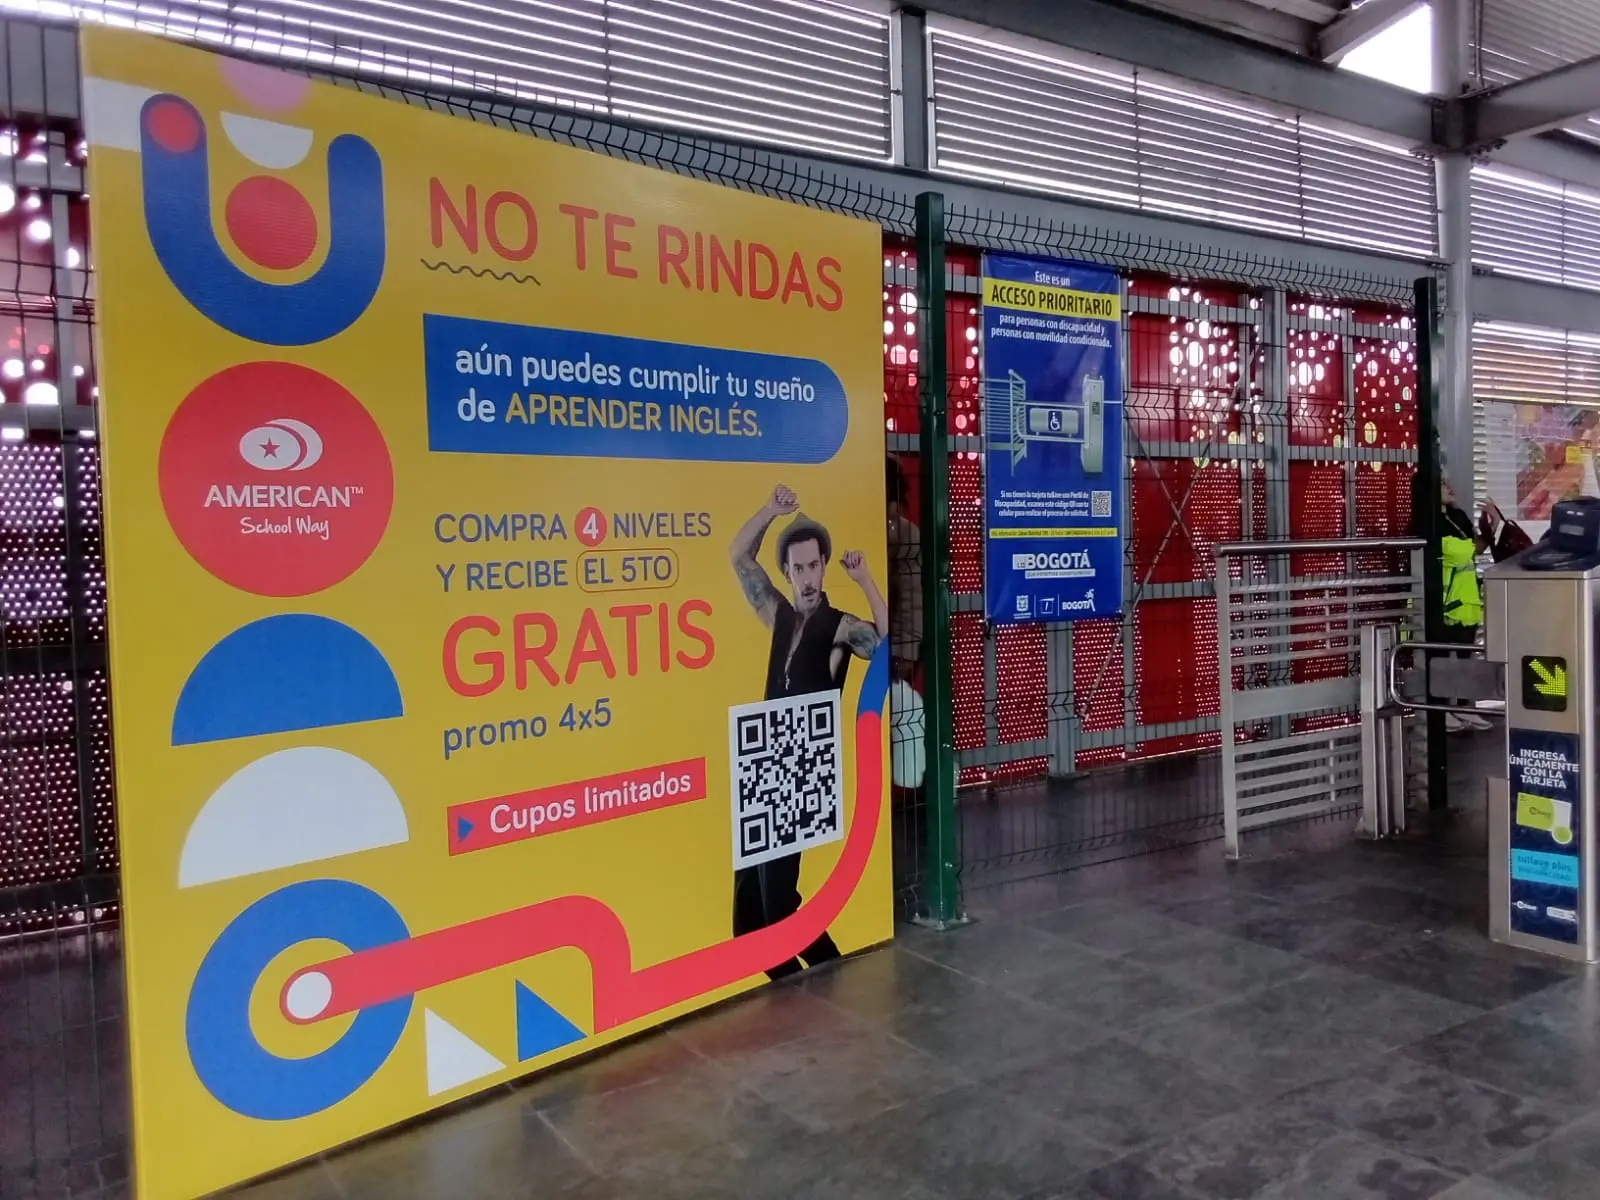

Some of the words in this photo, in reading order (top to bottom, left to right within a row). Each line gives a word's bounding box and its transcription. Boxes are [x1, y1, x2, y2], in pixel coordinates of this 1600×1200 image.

[429, 176, 538, 262] NO
[558, 203, 638, 279] TE
[657, 223, 843, 312] RINDAS
[1035, 271, 1050, 283] Este
[1051, 274, 1060, 285] es
[1061, 276, 1071, 286] un
[992, 285, 1035, 306] ACCESO
[1039, 292, 1112, 316] PRIORITARIO
[991, 327, 1022, 338] personas
[1023, 331, 1035, 340] con
[1036, 331, 1068, 344] movilidad
[1069, 336, 1113, 348] condicionada.
[999, 314, 1015, 325] para
[1016, 316, 1046, 327] personas
[1047, 320, 1058, 329] con
[1059, 319, 1101, 334] discapacidad
[1101, 326, 1105, 336] y
[455, 343, 512, 376] aún
[522, 352, 621, 387] puedes
[628, 365, 719, 400] cumplir
[725, 371, 748, 397] tu
[754, 376, 815, 402] sueño
[457, 389, 496, 423] de
[505, 393, 662, 432] APRENDER
[669, 402, 763, 438] INGLÉS.
[240, 516, 292, 534] School
[295, 514, 329, 540] Way
[434, 513, 568, 543] COMPRA
[582, 512, 599, 540] 4
[613, 512, 712, 538] NIVELES
[1026, 549, 1091, 569] BOGOTÁ
[435, 563, 456, 592] Y
[466, 558, 569, 591] RECIBE
[584, 557, 614, 584] EL
[621, 555, 673, 584] 5TO
[442, 598, 716, 698] GRATIS
[443, 715, 548, 761] promo
[558, 697, 613, 732] 4x5
[1509, 754, 1580, 773] ÚNICAMENTE
[1520, 748, 1567, 762] INGRESA
[1520, 774, 1567, 789] TARJETA
[1523, 767, 1546, 777] CON
[1549, 770, 1563, 779] LA
[489, 801, 576, 838] Cupos
[583, 770, 692, 814] limitados
